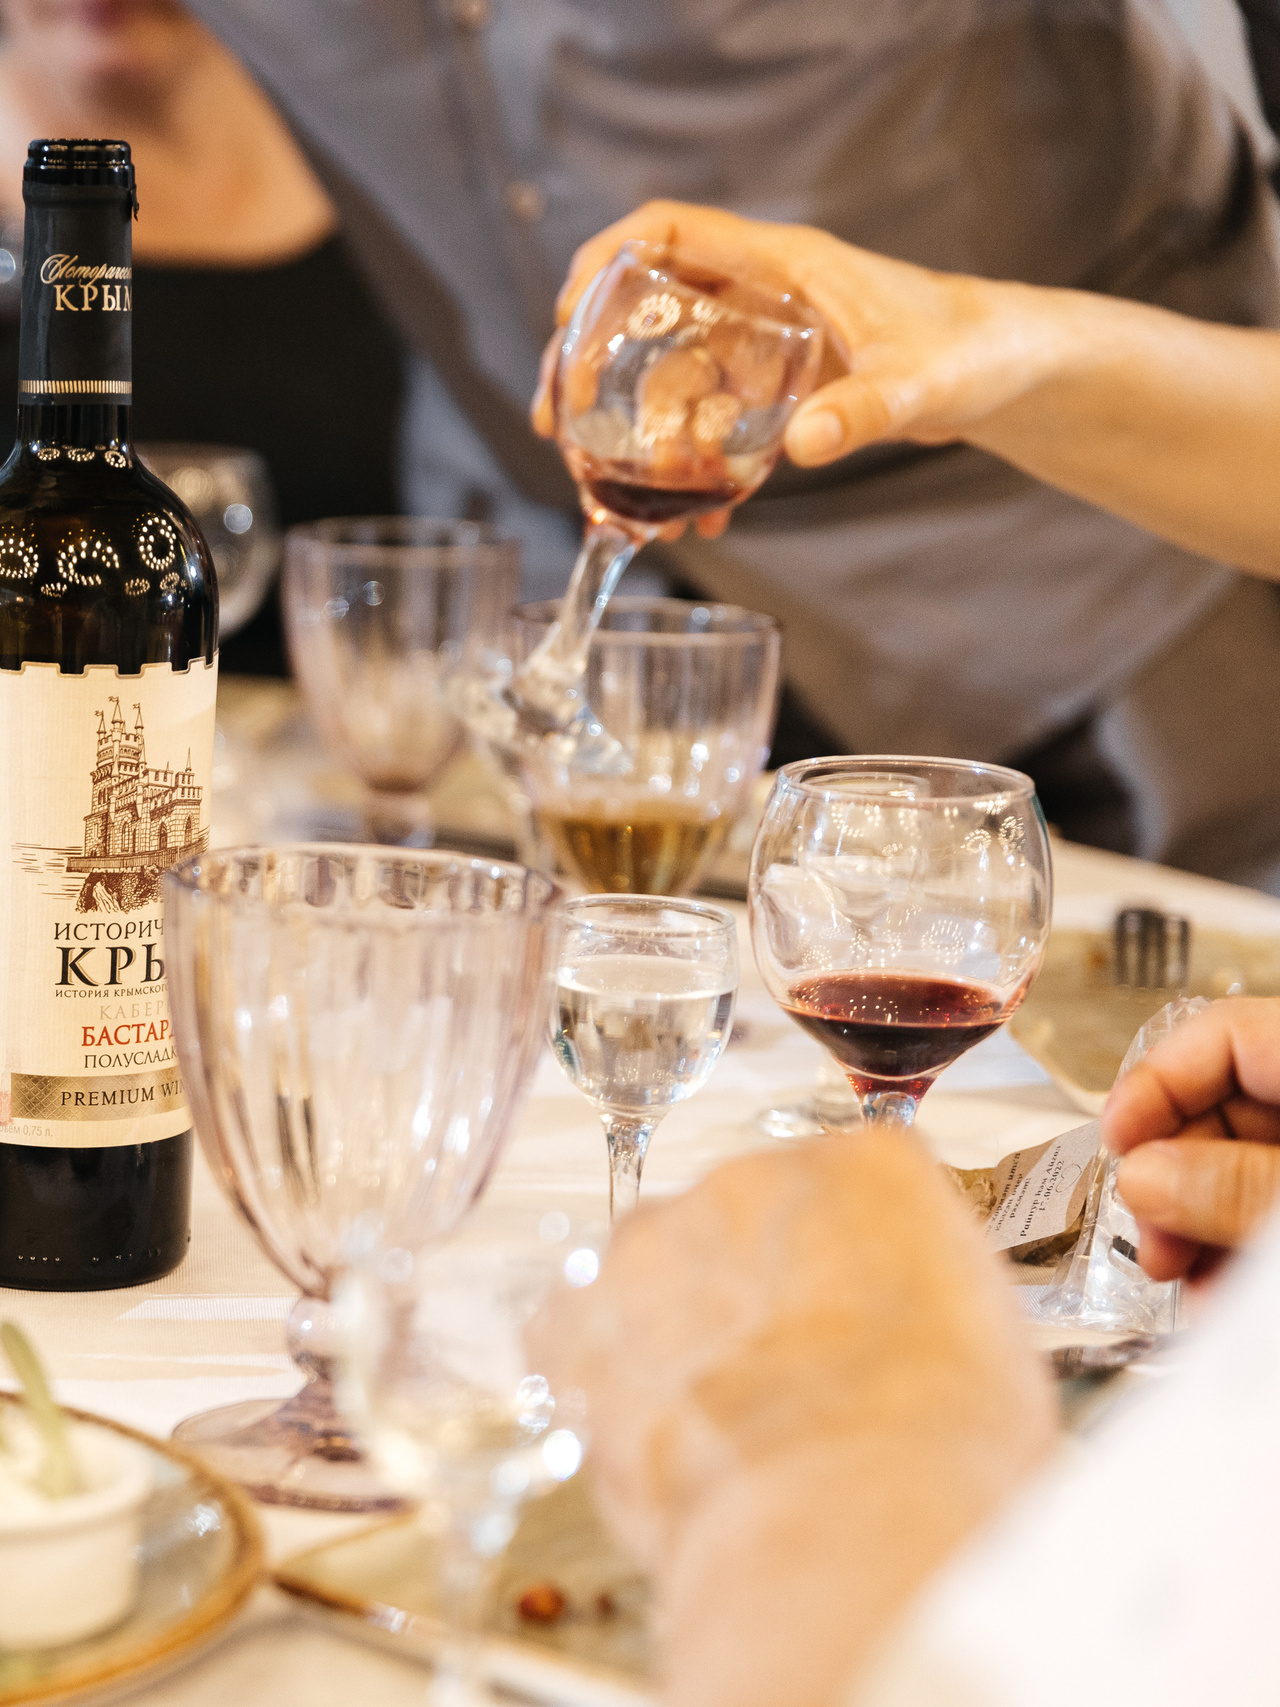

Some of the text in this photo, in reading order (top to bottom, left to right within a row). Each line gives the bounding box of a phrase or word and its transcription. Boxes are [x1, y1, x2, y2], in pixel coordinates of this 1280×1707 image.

[55, 989, 109, 999] ИСТОРИЯ
[61, 1086, 155, 1106] PREMIUM
[23, 1124, 42, 1137] 0,75
